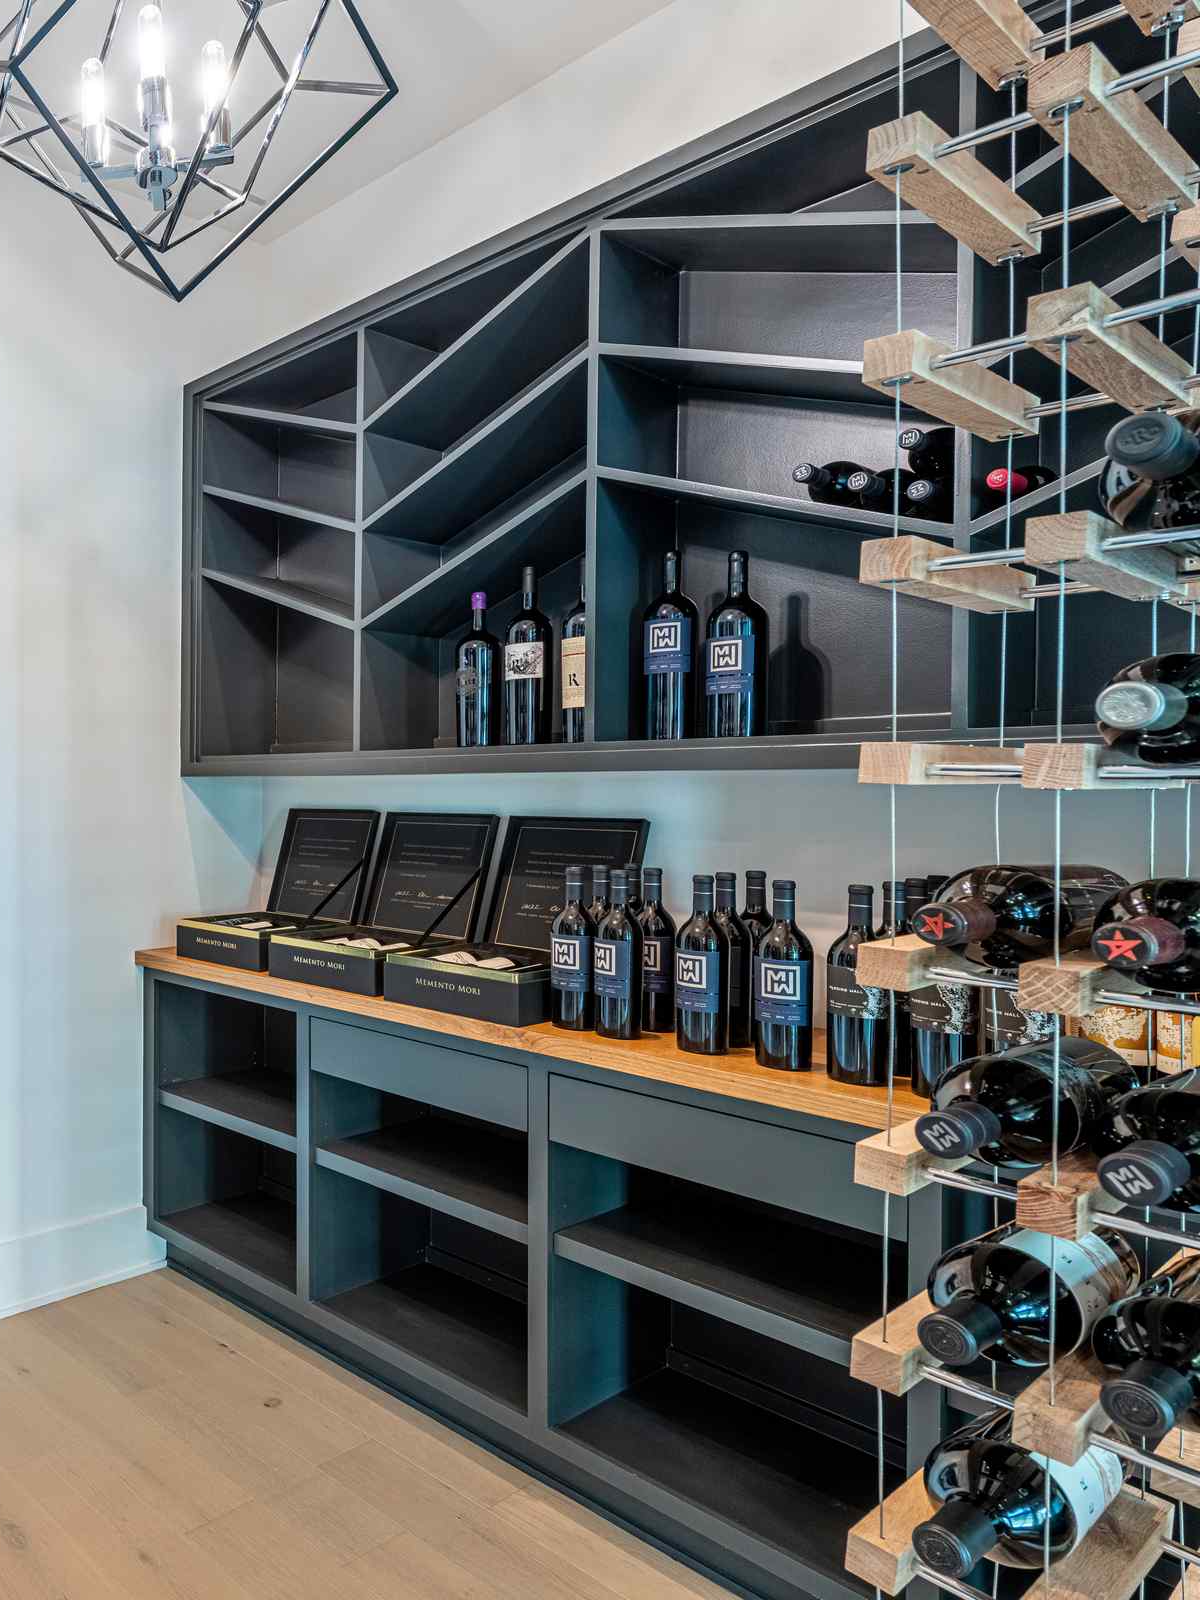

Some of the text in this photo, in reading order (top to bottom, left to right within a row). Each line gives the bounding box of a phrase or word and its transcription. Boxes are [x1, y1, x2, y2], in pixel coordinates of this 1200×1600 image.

[568, 672, 580, 687] R
[196, 937, 237, 950] MEMENTO MORI
[293, 955, 345, 971] MEMENTO MORI
[415, 977, 481, 996] MEMENTO MORI
